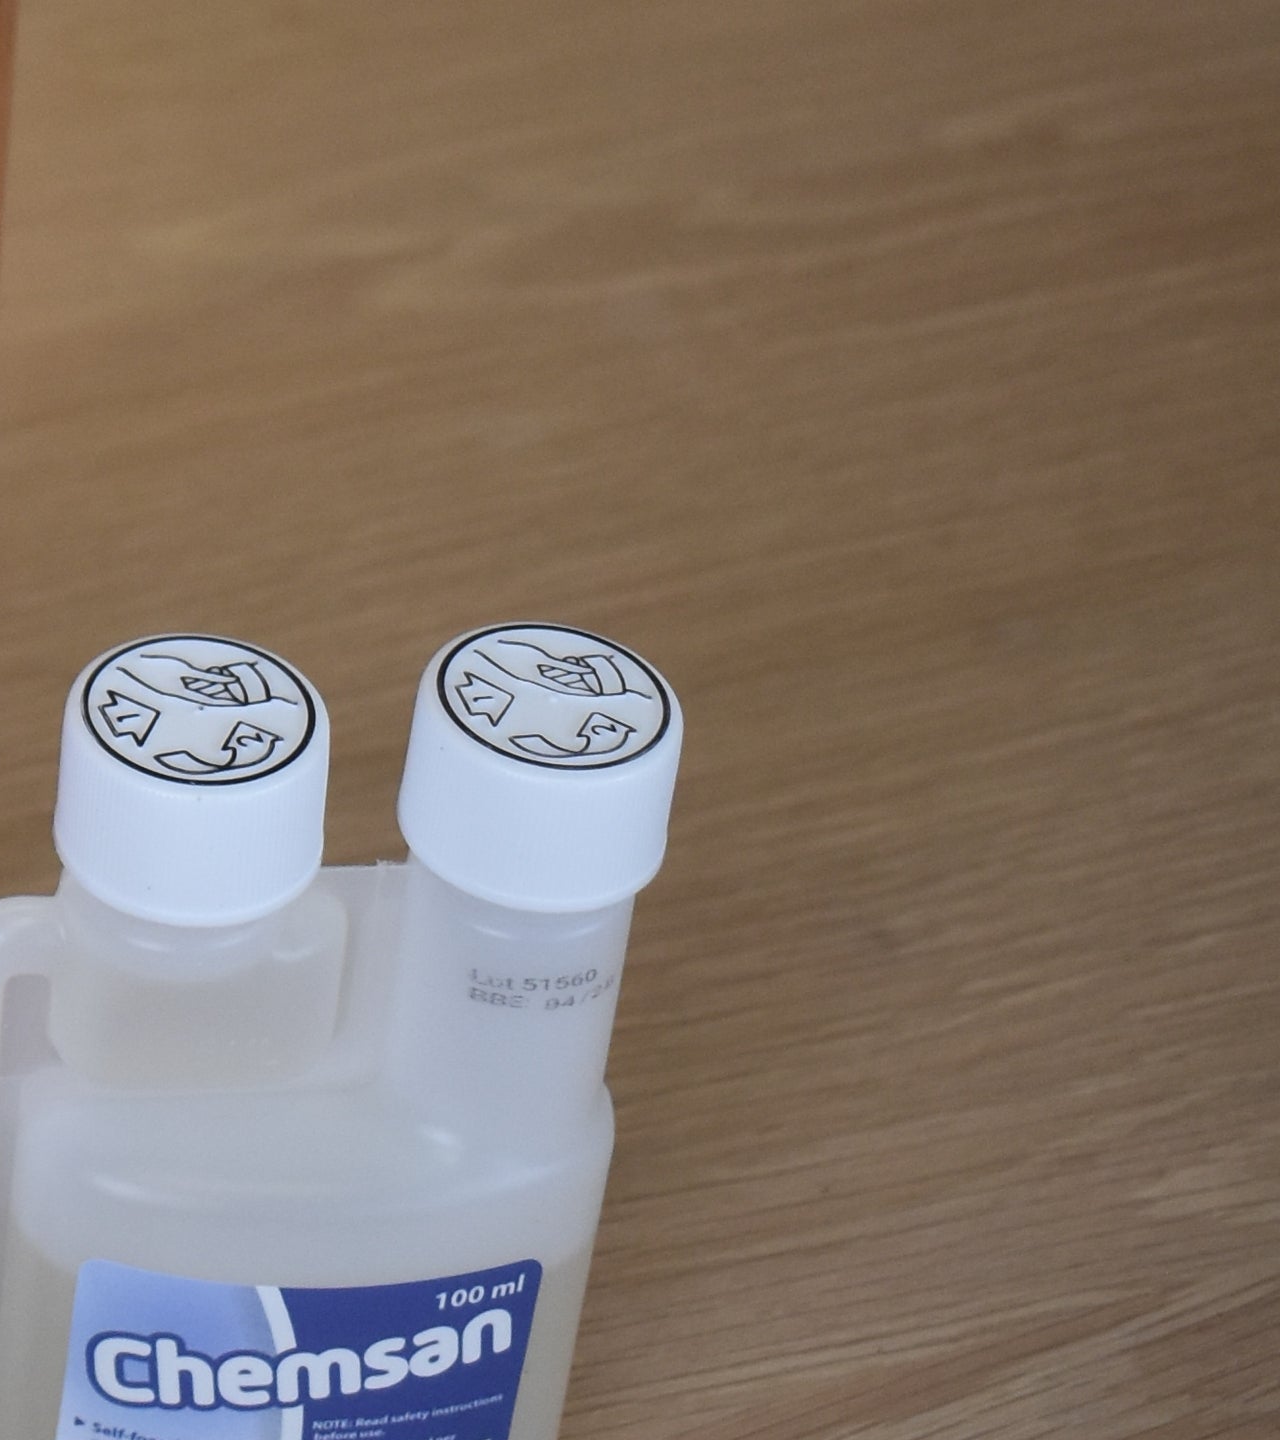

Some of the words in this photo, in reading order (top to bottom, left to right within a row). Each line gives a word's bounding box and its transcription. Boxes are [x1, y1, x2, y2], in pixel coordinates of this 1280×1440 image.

[436, 1285, 485, 1310] 100
[491, 1273, 525, 1299] ml
[91, 1307, 512, 1408] Chemsan
[355, 1416, 388, 1428] Read
[391, 1410, 429, 1424] safety
[432, 1394, 504, 1417] instructions
[359, 1429, 385, 1439] use.
